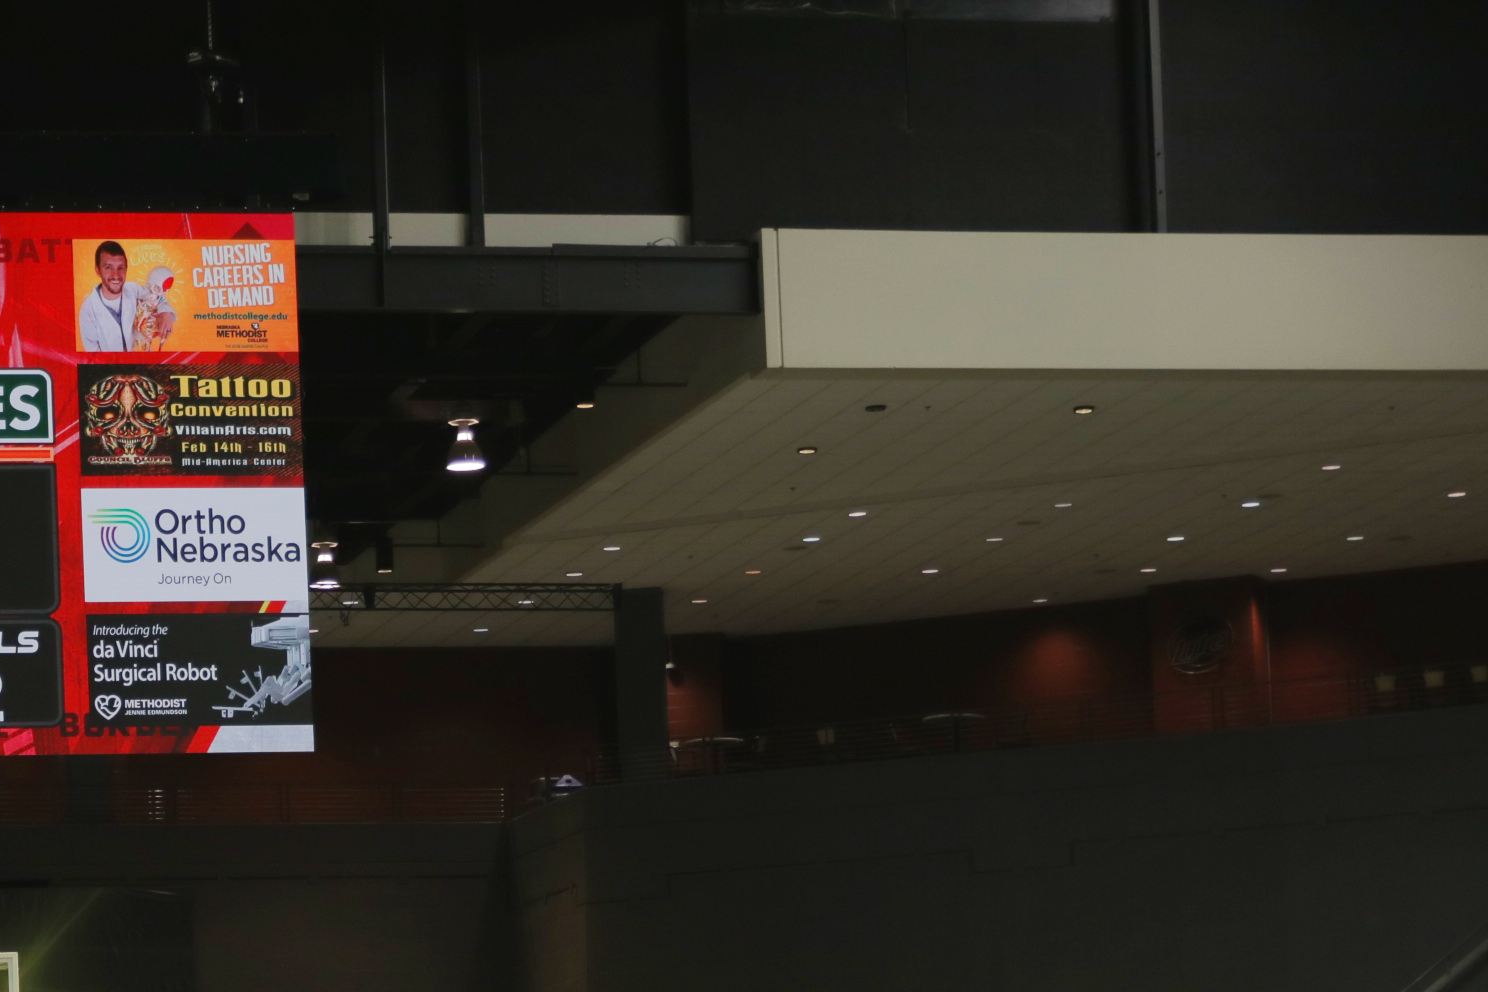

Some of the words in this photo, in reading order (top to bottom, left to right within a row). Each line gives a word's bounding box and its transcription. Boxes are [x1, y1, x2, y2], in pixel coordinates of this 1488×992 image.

[201, 242, 271, 266] NURSING
[192, 265, 263, 288] CAREERS
[268, 264, 285, 284] IN
[207, 286, 274, 308] DEMAND
[194, 312, 288, 322] methodistcollege.edu
[216, 330, 268, 338] METHODIST
[169, 375, 292, 398] Tattoo
[170, 403, 294, 417] Convention
[175, 425, 292, 436] VillainArts.com
[181, 442, 207, 453] Feb
[214, 442, 242, 453] 14th
[258, 442, 286, 453] 16th
[181, 458, 248, 467] Mid-America
[253, 457, 286, 466] Center
[154, 508, 246, 535] Ortho
[156, 536, 301, 563] Nebraska
[157, 573, 210, 587] Journey
[213, 573, 232, 584] On
[93, 624, 150, 638] Introducing
[151, 625, 168, 635] the
[93, 641, 115, 658] da
[116, 640, 158, 658] Vinci
[94, 663, 162, 687] Surgical
[166, 663, 218, 681] Robot
[124, 699, 187, 708] METHODIST
